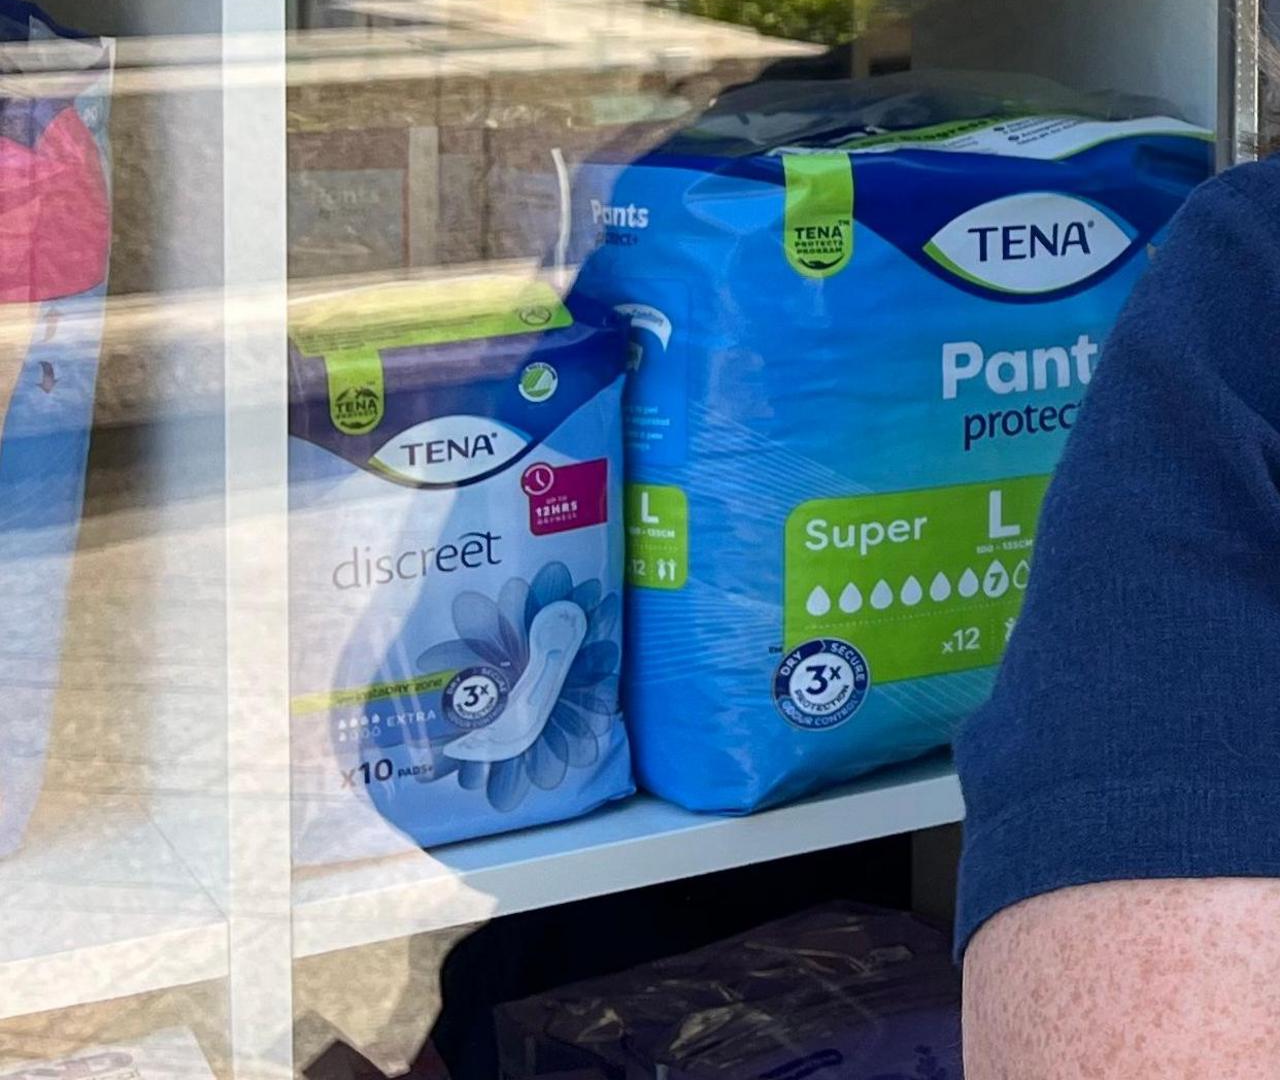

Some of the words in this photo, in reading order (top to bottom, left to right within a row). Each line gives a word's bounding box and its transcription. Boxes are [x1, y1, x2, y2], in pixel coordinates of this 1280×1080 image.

[590, 199, 649, 229] Pants
[942, 335, 1098, 400] Pant
[964, 400, 1082, 451] protec
[641, 491, 659, 523] L
[805, 516, 927, 555] Super
[988, 490, 1021, 538] L
[333, 531, 502, 591] discreet
[989, 572, 1003, 592] 7
[942, 626, 981, 654] x12
[780, 650, 802, 676] DRY
[830, 642, 866, 682] SECURE
[793, 684, 851, 712] PROTECTION
[386, 709, 437, 728] EXTRA
